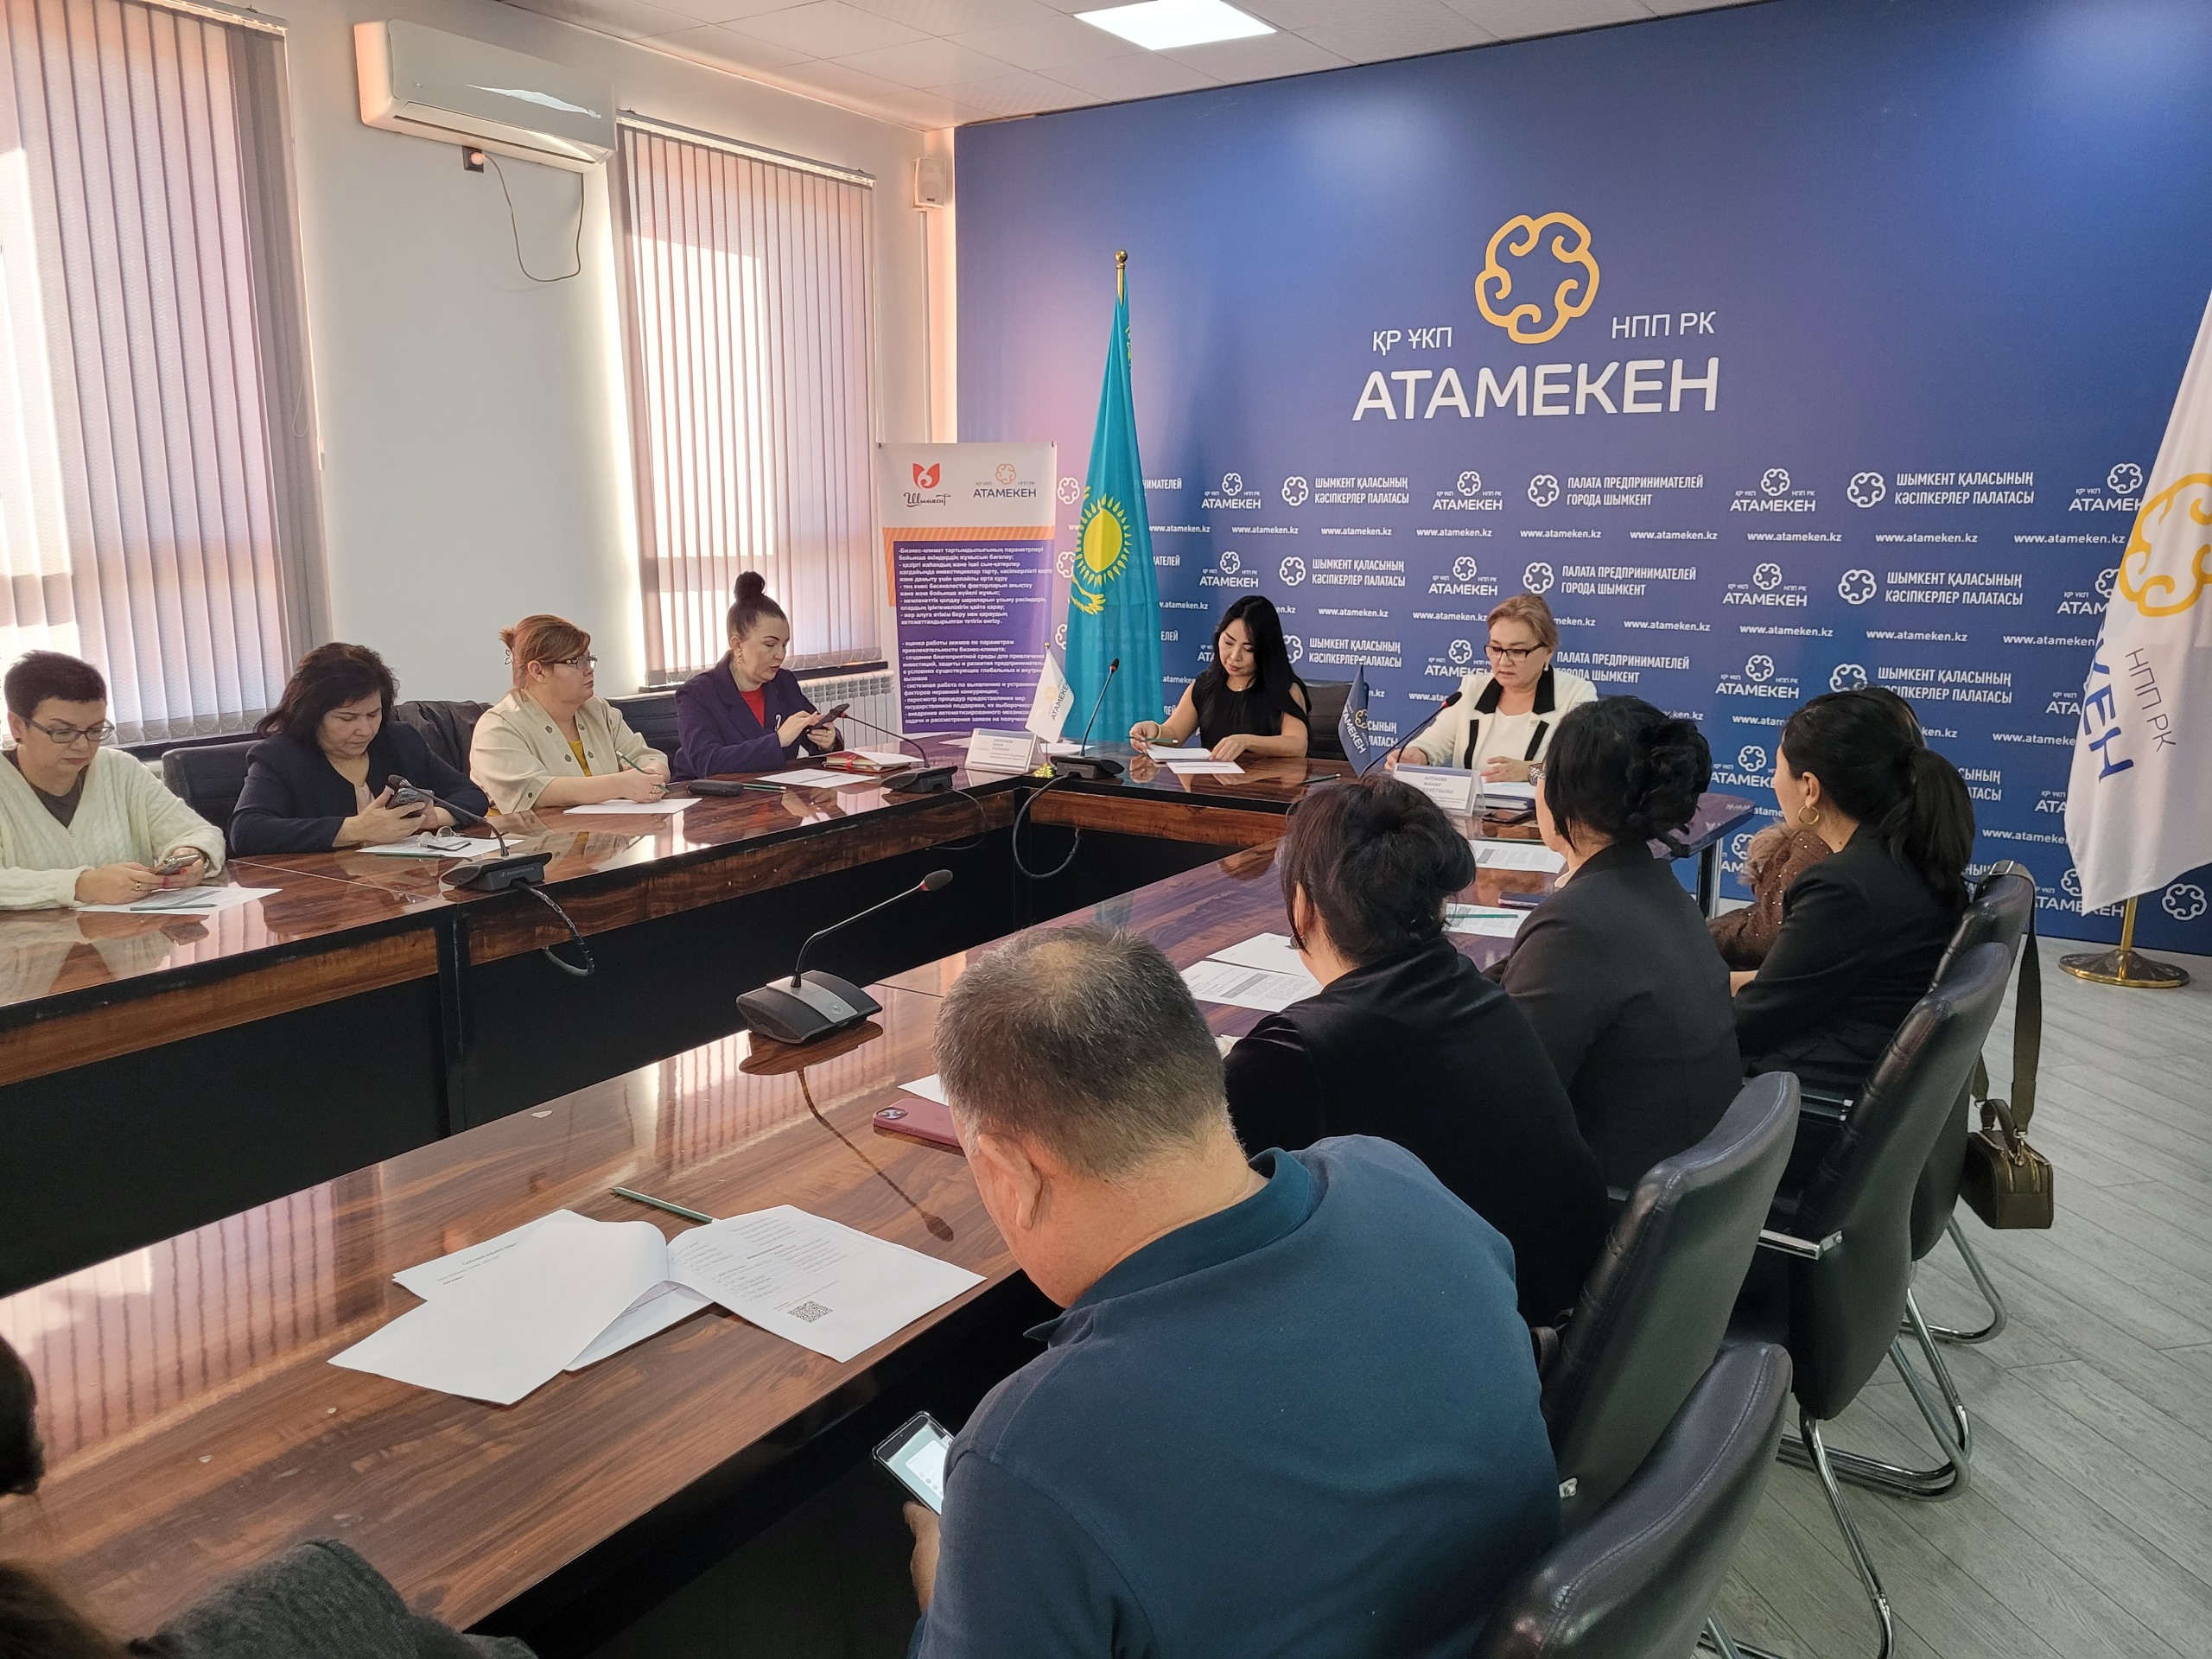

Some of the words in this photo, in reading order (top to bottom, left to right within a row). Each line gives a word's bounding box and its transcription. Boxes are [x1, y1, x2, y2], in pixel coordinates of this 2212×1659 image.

[1611, 314, 1670, 339] НПП
[1679, 311, 1716, 335] РК
[1371, 330, 1402, 356] ҚР
[1408, 327, 1452, 350] ҰКП
[1351, 356, 1719, 422] АТАМЕКЕН
[1142, 478, 1182, 490] НИМАТЕЛЕЙ
[1315, 477, 1356, 488] ШЫМКЕНТ
[1357, 477, 1408, 490] ҚАЛАСЫНЫҢ
[1567, 477, 1602, 489] ПАЛАТА
[1603, 474, 1704, 490] ПРЕДПРИНИМАТЕЛЕЙ
[1896, 473, 1956, 486] ШЫМКЕНТ
[1958, 471, 2034, 486] ҚАЛАСЫНЫҢ
[973, 488, 1037, 498] АТАМЕКЕН
[1314, 493, 1366, 504] КӘСІПКЕРЛЕР
[1367, 493, 1409, 504] ПАЛАТАСЫ
[1894, 492, 1970, 505] КӘСІПКЕРЛЕР
[1972, 491, 2035, 505] ПАЛАТАСЫ
[1201, 499, 1261, 509] АТАМЕКЕН
[1432, 499, 1503, 511] АТАМЕКЕН
[1567, 494, 1601, 507] ГОРОДА
[1603, 494, 1652, 505] ШЫМКЕНТ
[1730, 499, 1816, 512] АТАМЕКЕН
[2069, 498, 2143, 512] АТАМЕК
[1231, 525, 1300, 535] www.atameken.kz
[1320, 526, 1393, 536] www.atameken.kz
[1416, 528, 1493, 537] www.atameken.kz
[1520, 530, 1602, 538] www.atameken.kz
[1630, 531, 1718, 540] www.atameken.kz
[1747, 531, 1842, 542] www.atameken.kz
[1875, 532, 1979, 543] www.atameken.kz
[2013, 533, 2126, 544] www.atameken.kz
[1312, 558, 1352, 570] ШЫМКЕНТ
[1354, 559, 1404, 573] ҚАЛАСЫНЫҢ
[1561, 565, 1596, 577] ПАЛАТА
[1598, 566, 1697, 581] ПРЕДПРИНИМАТЕЛЕЙ
[1198, 575, 1259, 588] АТАМЕКЕН
[1312, 573, 1363, 585] КӘСІПКЕРЛЕР
[1363, 575, 1406, 587] ПАЛАТАСЫ
[1886, 572, 1946, 586] ШЫМКЕНТ
[1947, 572, 2023, 588] ҚАЛАСЫНЫҢ
[1427, 583, 1498, 596] АТАМЕКЕН
[1560, 582, 1596, 594] ГОРОДА
[1597, 582, 1646, 596] ШЫМКЕНТ
[1722, 592, 1808, 607] АТАМЕКЕН
[1885, 590, 1961, 605] КӘСІПКЕРЛЕР
[1961, 591, 2024, 606] ПАЛАТАСЫ
[1160, 601, 1208, 610] .atameken.kz
[2056, 601, 2110, 615] АТАМ
[1318, 607, 1389, 618] www.atameken.kz
[1412, 611, 1488, 622] www.atameken.kz
[1553, 617, 1596, 627] meken.kz
[1623, 620, 1711, 632] www.atameken.kz
[1739, 624, 1834, 638] www.atameken.kz
[1866, 629, 1969, 642] www.atameken.kz
[1309, 637, 1350, 650] ШЫМКЕНТ
[1350, 639, 1402, 654] ҚАЛАСЫНЫҢ
[2003, 634, 2095, 647] www.atameken
[1308, 652, 1358, 665] КӘСІПКЕРЛЕР
[1556, 652, 1591, 664] ПАЛАТА
[1592, 652, 1690, 671] ПРЕДПРИНИМАТЕЛЕЙ
[1557, 667, 1590, 680] РОДА
[1591, 669, 1640, 683] ШЫМКЕНТ
[1878, 666, 1936, 683] ШЫМКЕНТ
[1937, 669, 2012, 687] ҚАЛАСЫНЫҢ
[1715, 683, 1800, 699] АТАМЕКЕН
[1878, 685, 1949, 701] СІПКЕРЛЕР
[1952, 688, 2012, 704] ПАЛАТАСЫ
[2125, 647, 2162, 710] НПП
[2146, 713, 2177, 753] РК
[1367, 720, 1397, 734] СЫНЫҢ
[1732, 714, 1787, 727] www.atam
[1368, 735, 1398, 747] ЛАТАСЫ
[1992, 732, 2076, 746] www.atameke
[1710, 771, 1775, 789] АТАМЕКЕ
[1957, 767, 2001, 785] СЫНЫҢ
[1982, 829, 2068, 845] www.atameke
